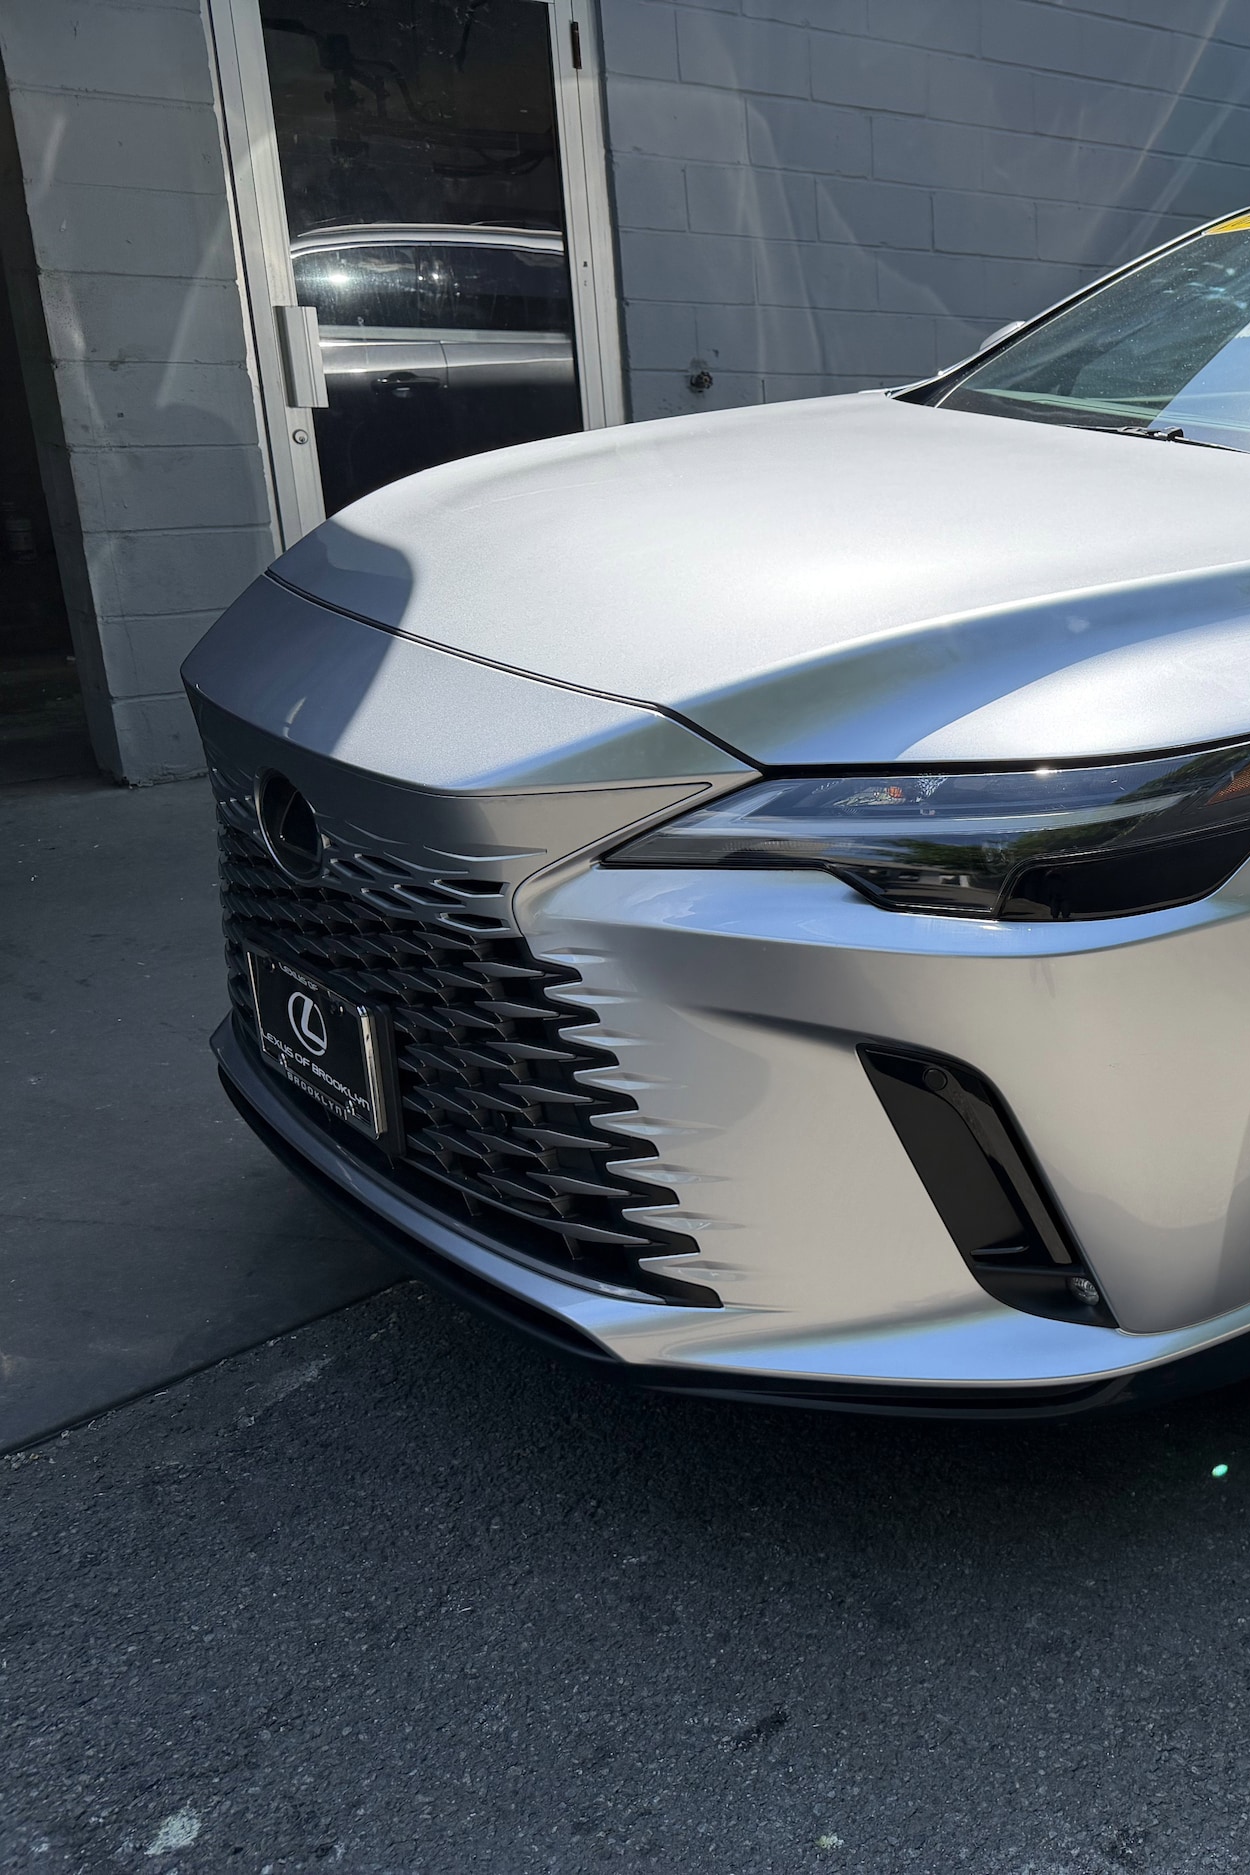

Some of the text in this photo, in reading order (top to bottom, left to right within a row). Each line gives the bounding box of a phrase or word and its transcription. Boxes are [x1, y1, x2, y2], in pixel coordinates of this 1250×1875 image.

[278, 961, 319, 991] LEXUS OF
[261, 1027, 371, 1111] LEXUS OF BROOKLYN
[286, 1071, 343, 1117] BROOKLYN
